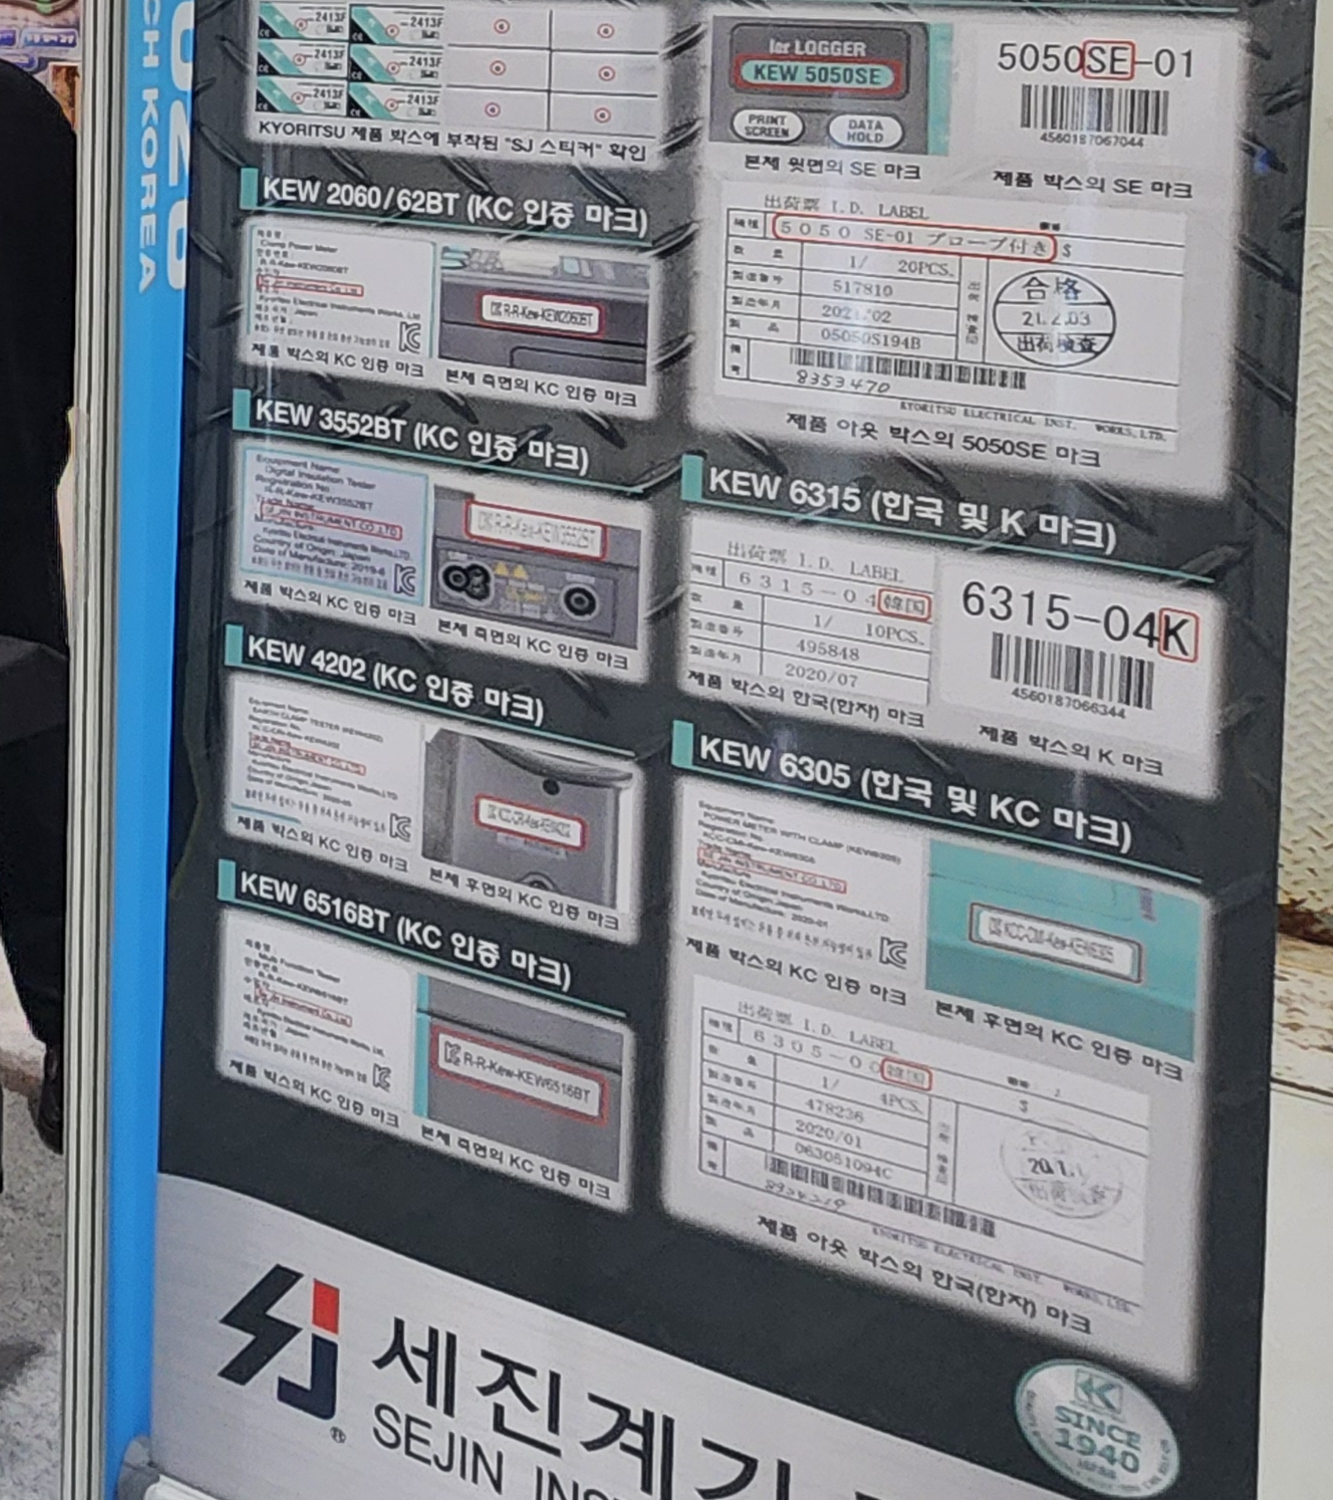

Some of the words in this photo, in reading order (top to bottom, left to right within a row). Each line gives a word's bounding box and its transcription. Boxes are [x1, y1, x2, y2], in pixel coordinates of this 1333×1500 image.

[753, 64, 799, 82] KEW
[805, 65, 882, 86] 5050SE
[997, 41, 1195, 78] 5050SE-01
[258, 120, 346, 140] KYORITSU
[351, 126, 383, 144] 제품
[448, 131, 499, 152] 부착된
[610, 143, 647, 162] 확인
[138, 88, 158, 294] KOREA
[262, 178, 320, 204] KEW
[466, 198, 514, 224] (KC
[523, 201, 574, 229] 인증
[586, 207, 648, 237] 마크)
[255, 399, 314, 426] KEW
[318, 408, 408, 443] 3552BT
[413, 425, 459, 452] (KC
[468, 430, 518, 461] 인증
[528, 439, 590, 476] 마크)
[786, 411, 828, 433] 제품
[836, 419, 880, 441] 아웃
[889, 425, 955, 449] 박스의
[962, 434, 1049, 460] 5050SE
[1056, 445, 1102, 469] 마크
[708, 467, 781, 500] KEW
[789, 477, 862, 513] 6315
[871, 487, 944, 527] (한국
[958, 501, 988, 531] 및
[1001, 509, 1027, 536] K
[1039, 513, 1117, 554] 마크)
[961, 582, 1190, 658] 6315-04K
[247, 636, 306, 667] KEW
[310, 648, 367, 683] 4202
[372, 662, 417, 692] (KC
[425, 673, 475, 707] 인증
[484, 686, 544, 727] 마크)
[698, 736, 771, 771] KEW
[778, 750, 851, 787] 6305
[861, 764, 934, 806] (한국
[948, 783, 978, 816] 및
[990, 794, 1041, 828] KC
[1053, 806, 1132, 853] 마크)
[240, 871, 298, 906] KEW
[302, 887, 391, 934] 6516BT
[396, 912, 442, 950] (KC
[450, 928, 501, 969] 인증
[511, 946, 572, 992] 마크)
[372, 1403, 503, 1495] SEJIN
[1054, 1405, 1141, 1451] SINCE
[1054, 1427, 1141, 1474] 1940
